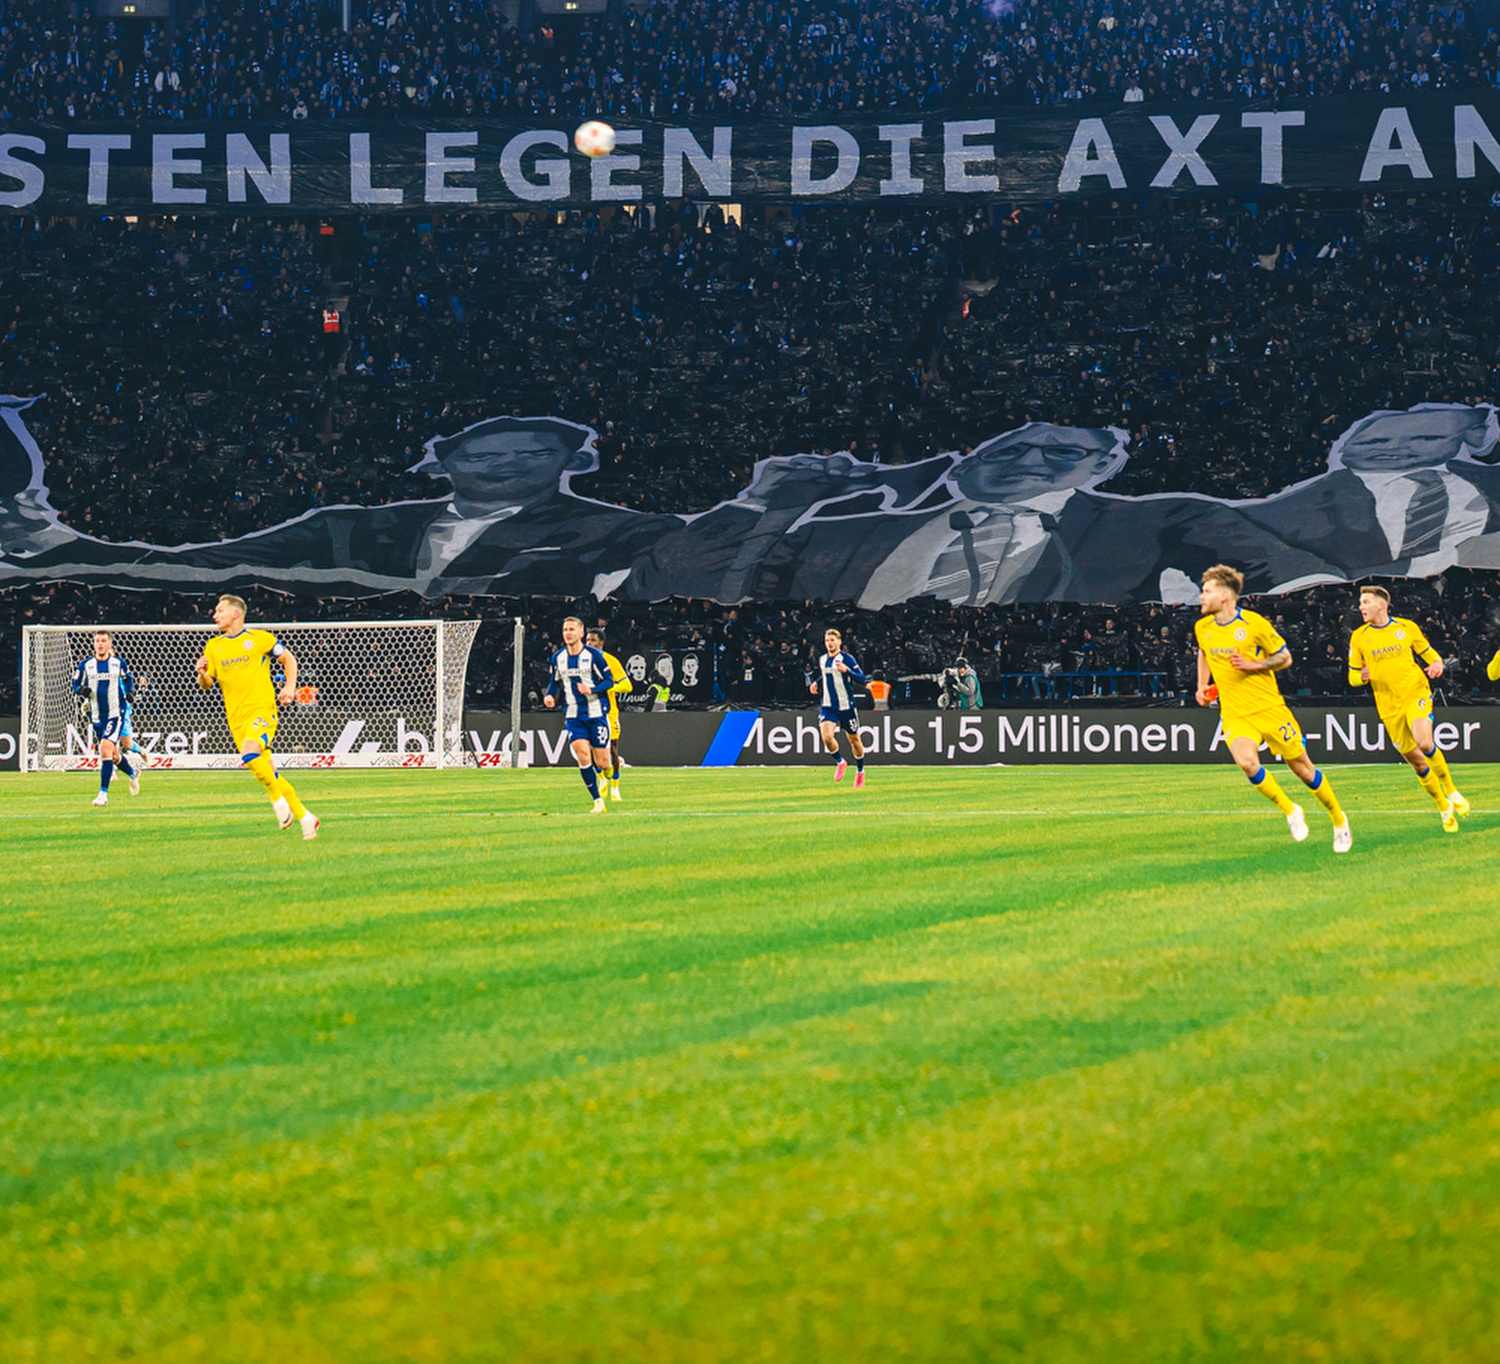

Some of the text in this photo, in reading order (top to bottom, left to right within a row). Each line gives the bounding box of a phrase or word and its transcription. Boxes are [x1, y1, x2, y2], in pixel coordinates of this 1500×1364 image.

[349, 126, 732, 204] LEGEN
[790, 118, 1000, 196] DIE
[1057, 110, 1306, 193] AXT
[857, 715, 916, 754] als
[928, 715, 984, 759] 1,5
[998, 714, 1196, 753] Millionen
[1278, 722, 1297, 742] 21
